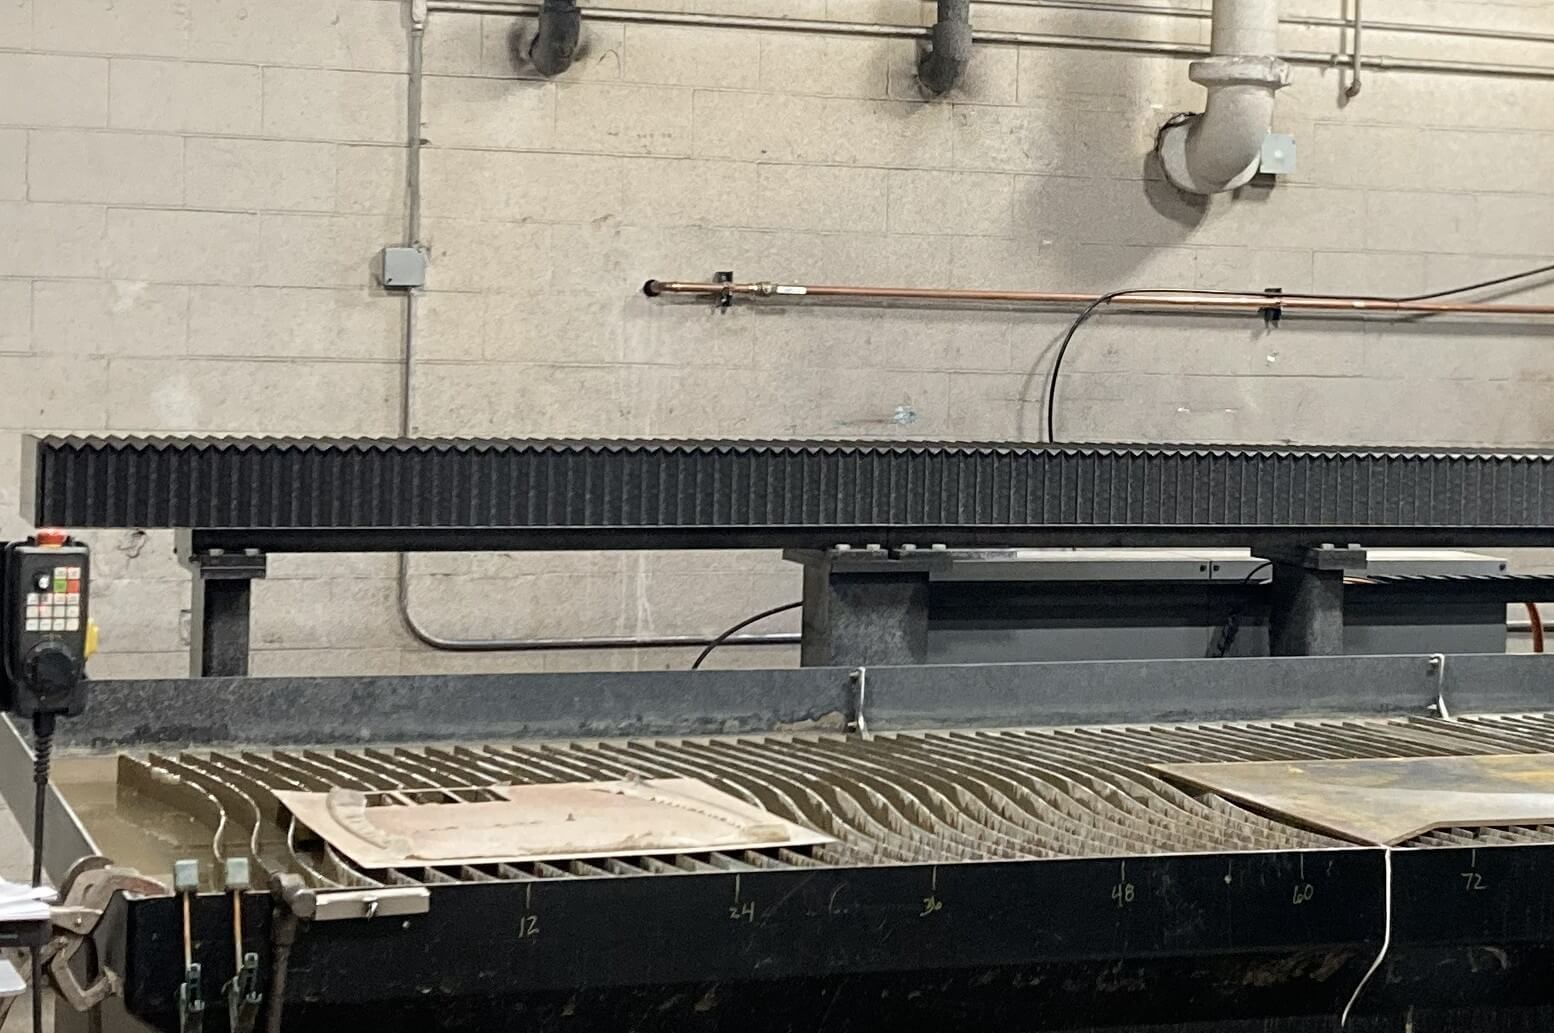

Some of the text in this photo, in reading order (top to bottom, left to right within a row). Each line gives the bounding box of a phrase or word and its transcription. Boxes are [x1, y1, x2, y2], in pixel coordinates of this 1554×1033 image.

[518, 914, 540, 939] 12
[729, 901, 755, 923] 24
[1111, 883, 1135, 908] 48
[1292, 883, 1314, 905] 60
[1460, 872, 1488, 891] 72
